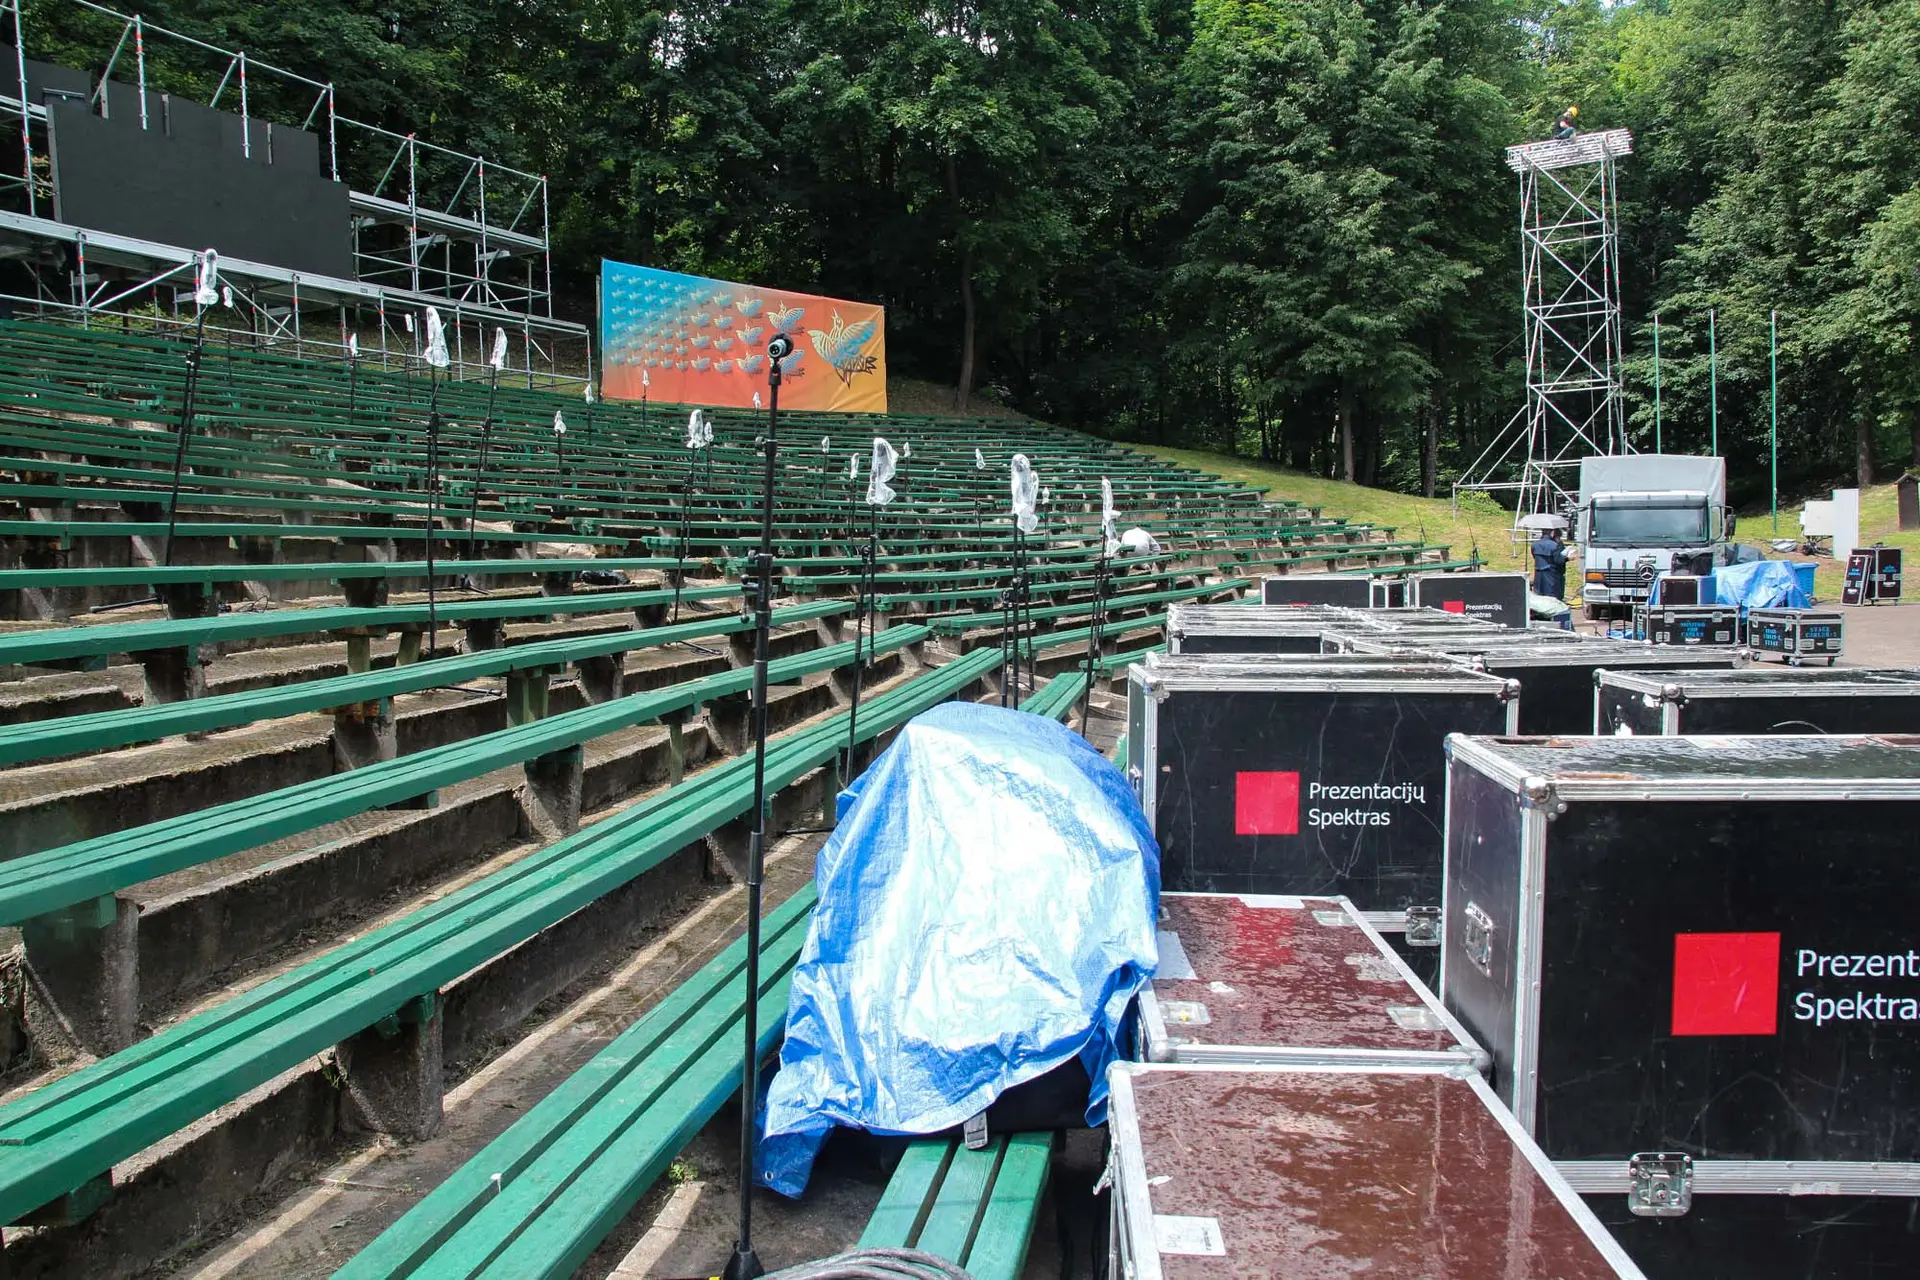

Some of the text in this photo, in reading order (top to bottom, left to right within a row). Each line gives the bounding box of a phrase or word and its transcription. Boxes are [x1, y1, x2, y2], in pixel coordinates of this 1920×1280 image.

[1309, 782, 1427, 804] Prezentacijų
[1307, 808, 1391, 830] Spektras
[1797, 949, 1920, 978] Prezent
[1794, 991, 1920, 1027] Spektra
